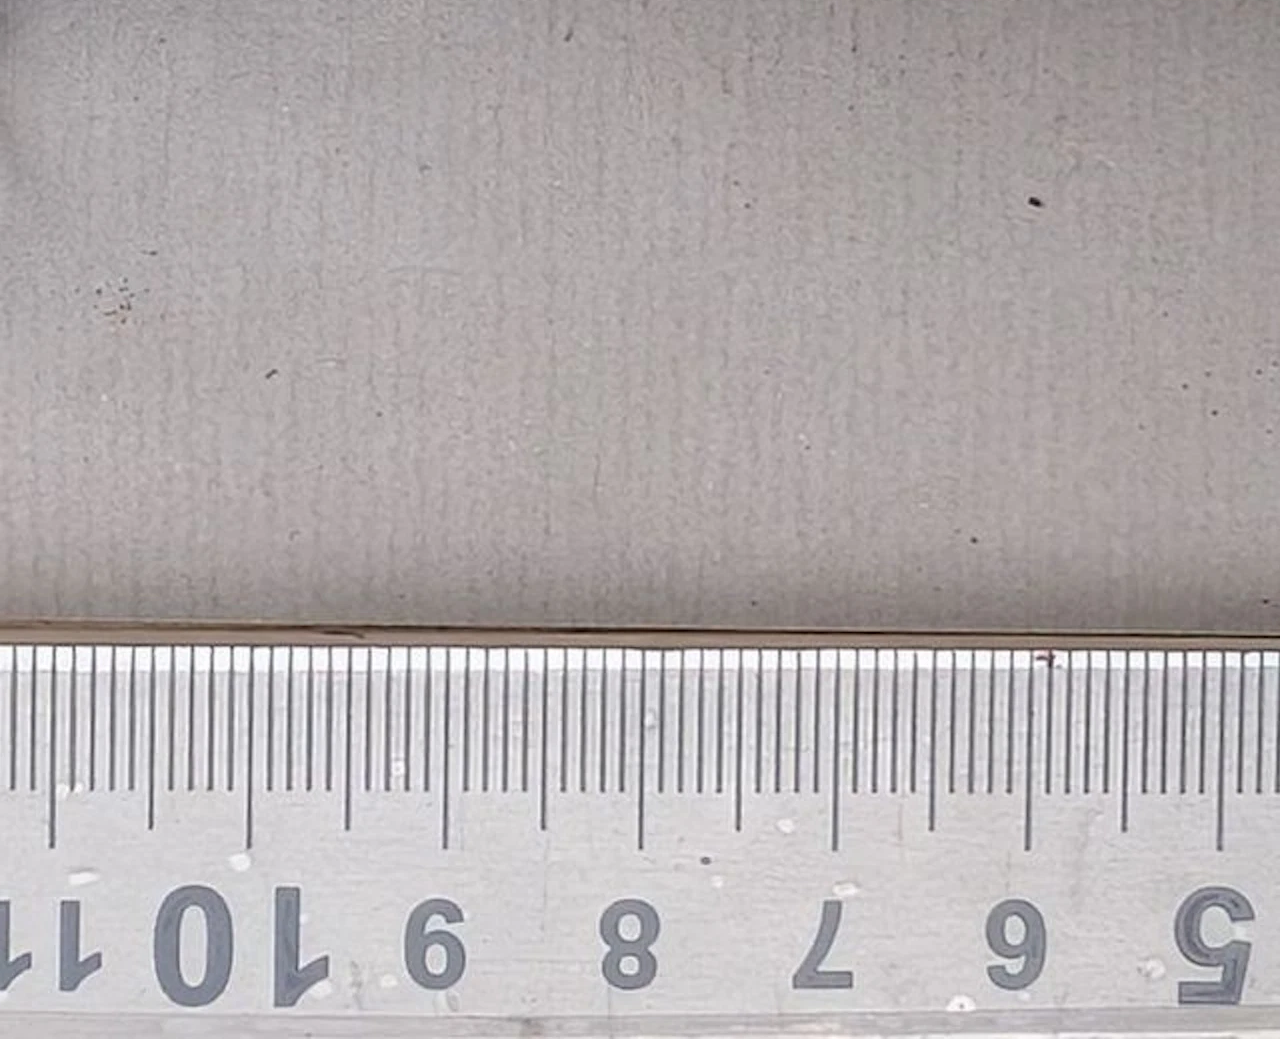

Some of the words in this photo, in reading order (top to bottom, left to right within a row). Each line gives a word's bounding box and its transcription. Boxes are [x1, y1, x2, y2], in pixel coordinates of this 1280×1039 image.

[153, 884, 329, 1008] 10
[404, 899, 466, 989] 9
[599, 899, 660, 989] 8
[792, 899, 853, 989] 7
[986, 899, 1046, 989] 6
[1174, 886, 1254, 1005] 5
